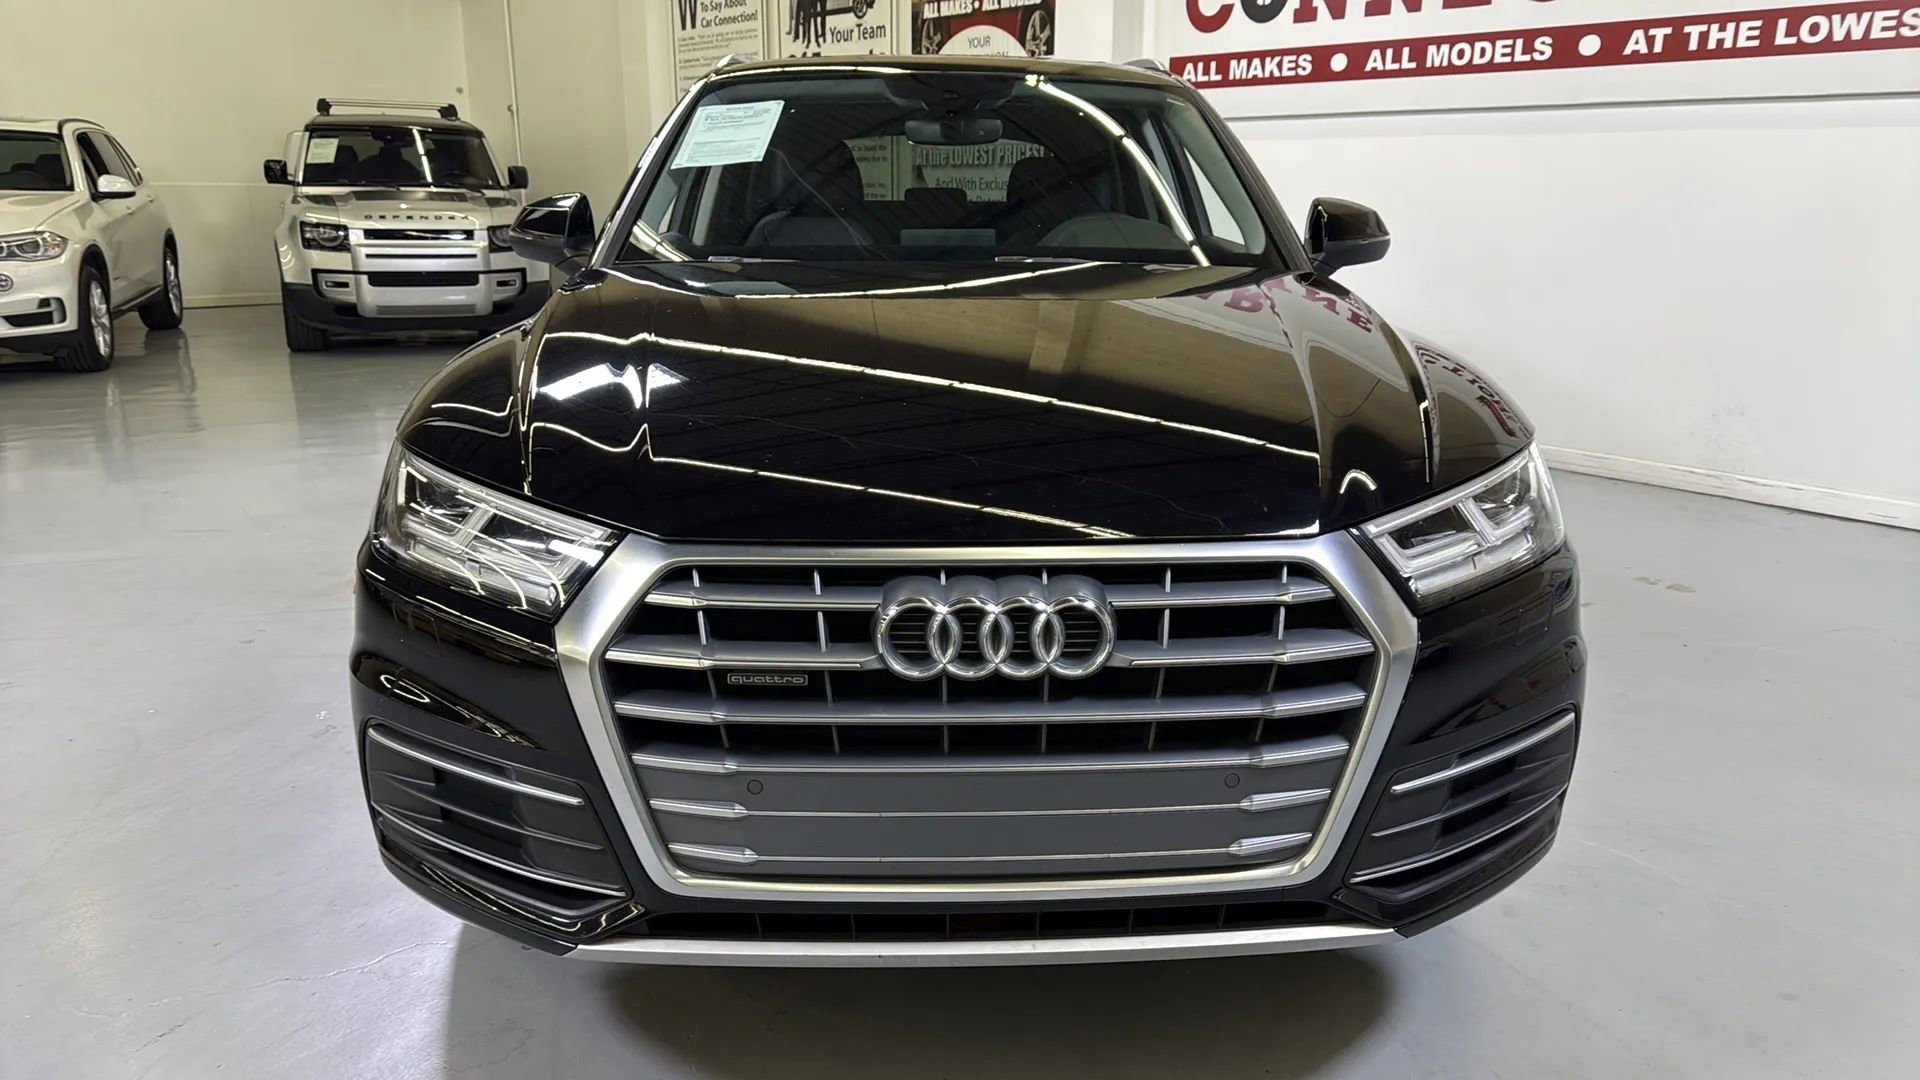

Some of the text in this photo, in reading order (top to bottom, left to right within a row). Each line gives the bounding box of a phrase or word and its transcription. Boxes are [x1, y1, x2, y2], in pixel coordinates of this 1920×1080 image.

[700, 2, 709, 13] To
[710, 0, 722, 12] Say
[923, 2, 940, 19] ALL
[941, 0, 973, 16] MAKES
[701, 10, 758, 28] Car Connection!
[829, 23, 887, 44] Your Team
[968, 35, 992, 49] YOUR
[1181, 7, 1920, 83] ALL MAKES ALL MODELS AT THE LOWES
[949, 146, 995, 166] LOWEST
[955, 176, 977, 191] With
[730, 675, 804, 684] quattro
